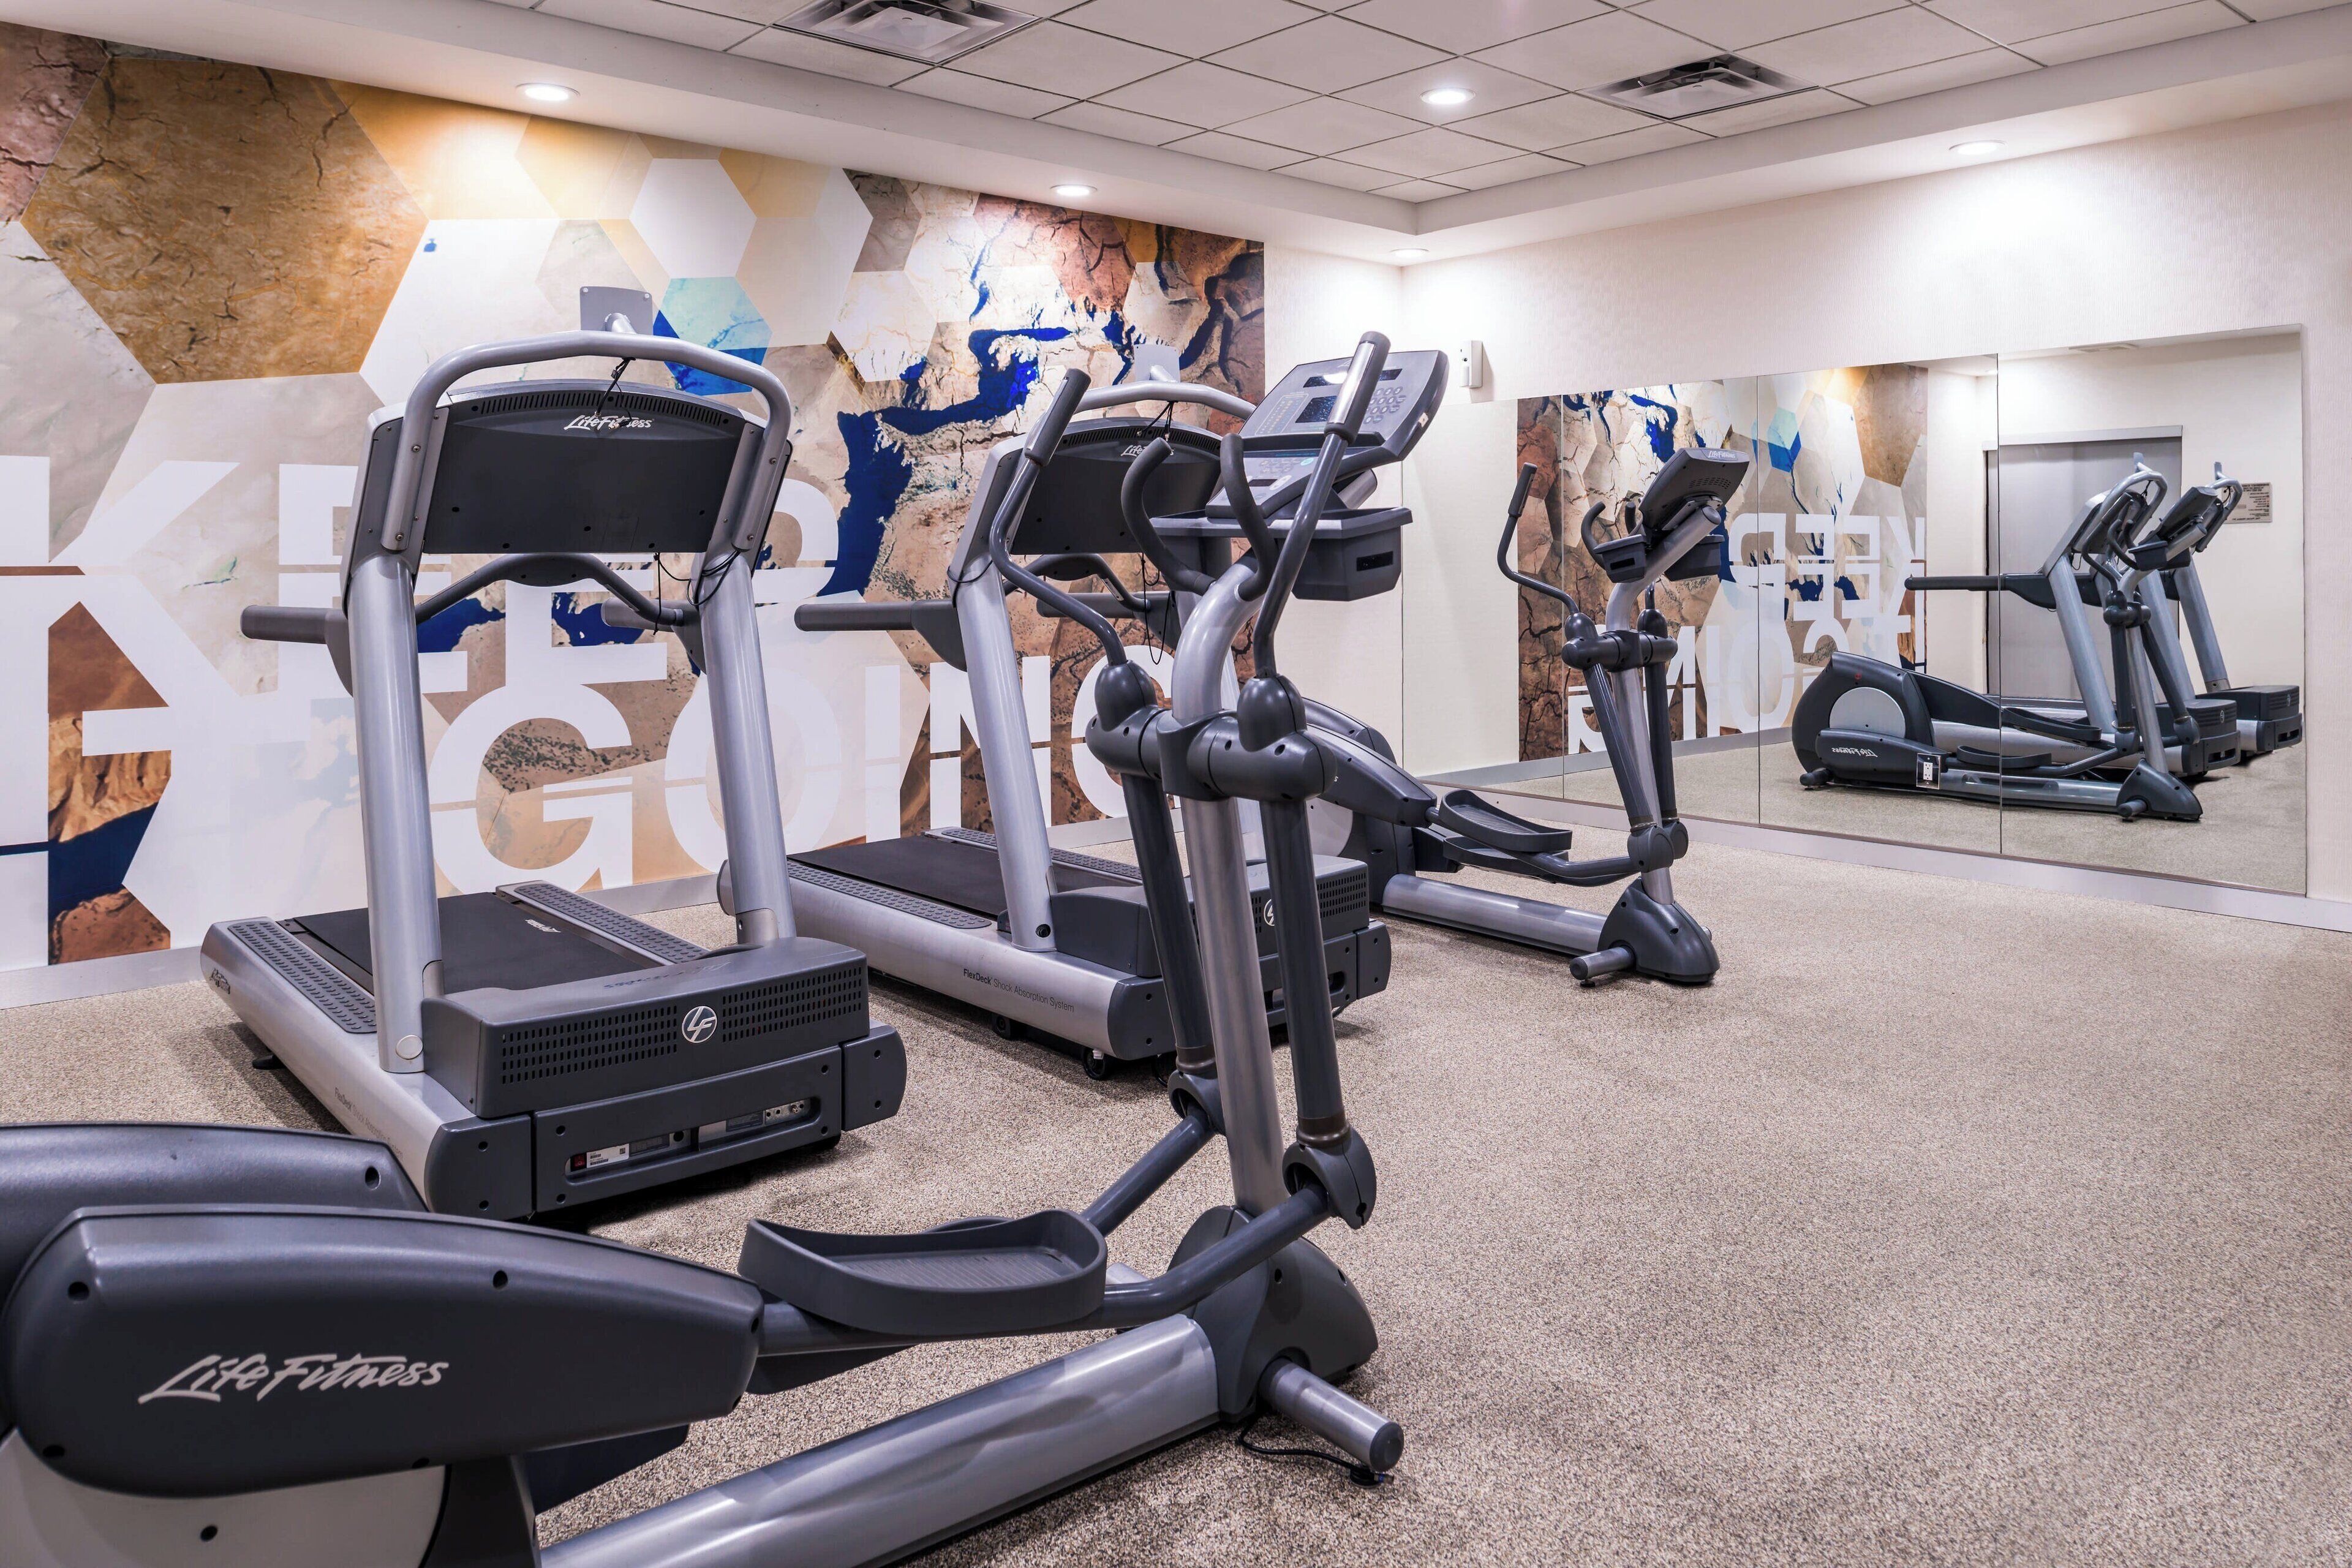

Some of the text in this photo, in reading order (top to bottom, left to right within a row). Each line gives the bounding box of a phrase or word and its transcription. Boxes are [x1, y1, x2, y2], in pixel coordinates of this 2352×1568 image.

[963, 968, 1074, 1012] FlexDeck Shock Absorption System
